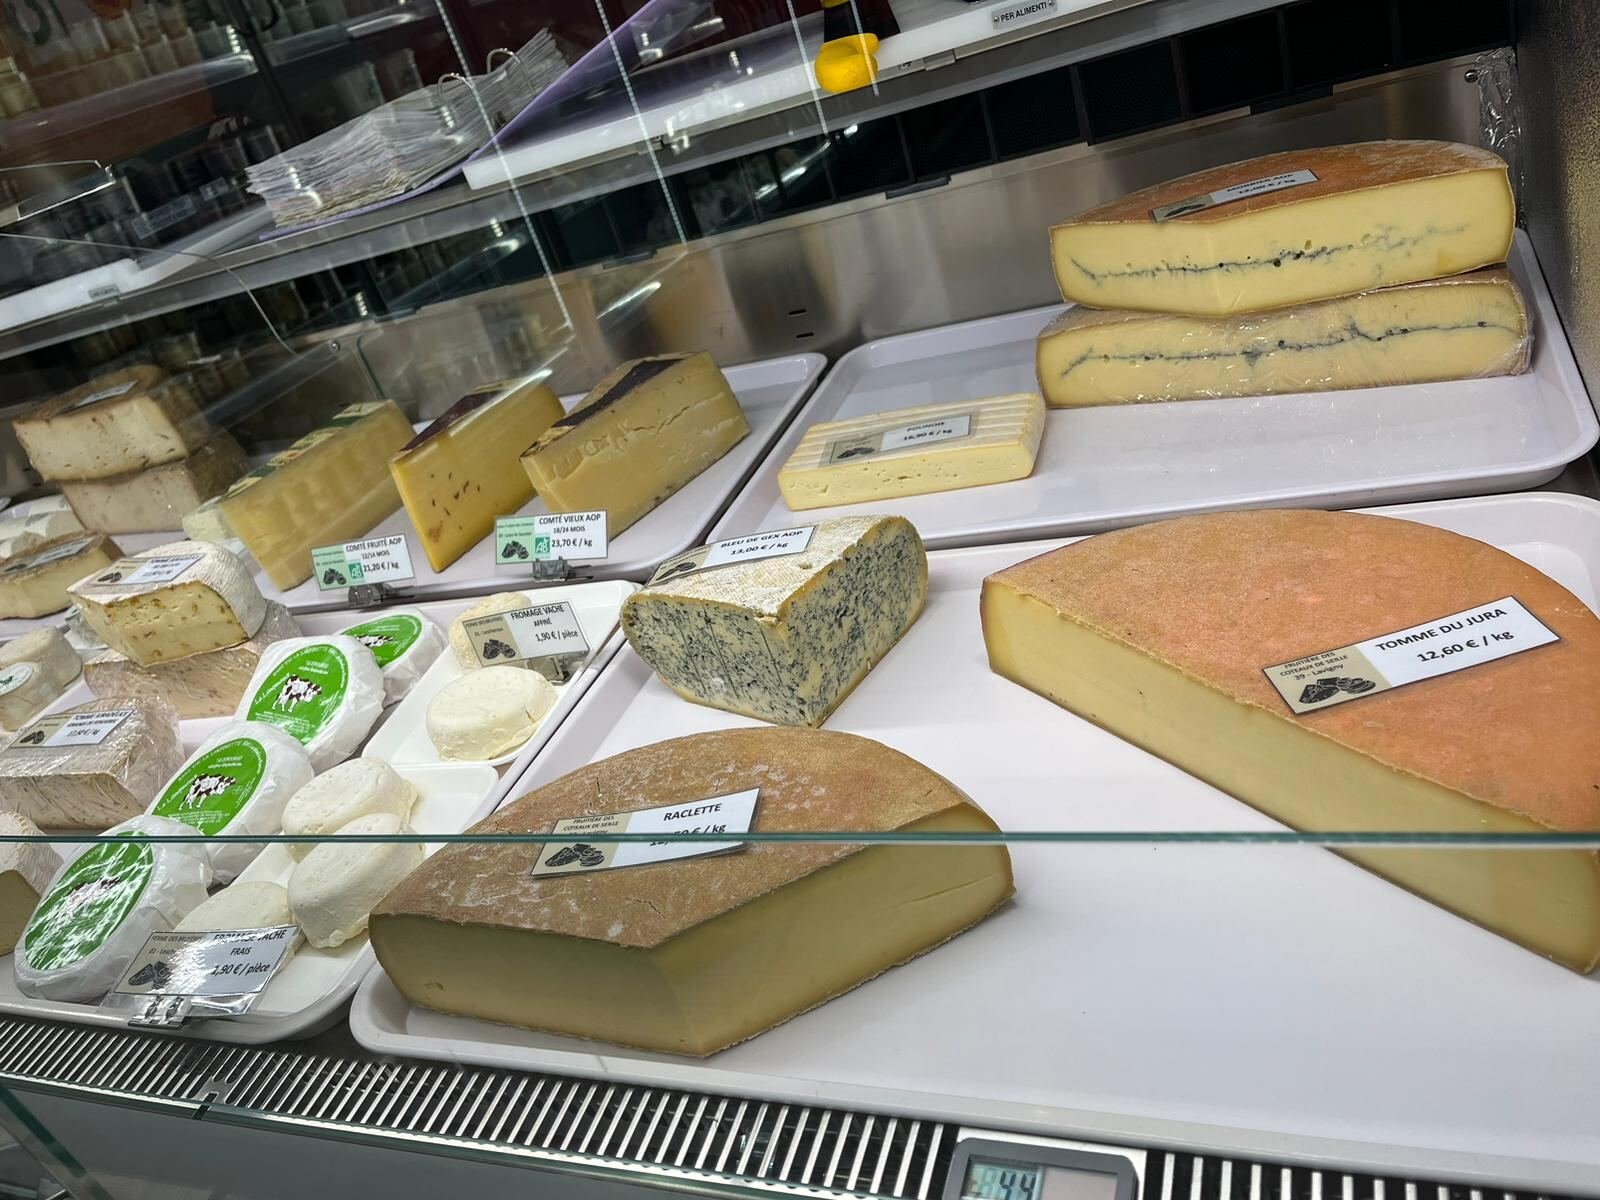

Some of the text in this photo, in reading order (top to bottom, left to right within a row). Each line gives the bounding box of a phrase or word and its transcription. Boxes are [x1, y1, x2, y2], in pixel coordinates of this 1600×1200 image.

[1000, 2, 1047, 22] PER ALIMENTI
[539, 513, 601, 525] COMTÉ VIEUX AOP
[388, 537, 402, 546] AOP
[552, 538, 570, 548] 23,70
[572, 538, 578, 546] €
[584, 538, 592, 547] kg
[720, 540, 744, 548] BLEU
[760, 533, 780, 541] GEX
[780, 530, 804, 538] AOP
[730, 546, 759, 556] 13,00
[381, 562, 386, 570] €
[392, 561, 400, 570] kg
[510, 606, 543, 620] FROMAGE
[543, 604, 565, 615] VACHE
[534, 617, 552, 627] AFFINÉ
[1375, 608, 1508, 652] TOMME DU JURA
[536, 632, 550, 643] 1,90
[551, 630, 558, 640] €
[562, 630, 579, 640] pièce
[1416, 630, 1515, 664] 12,60 € / kg
[1280, 664, 1314, 677] COTEAUX
[1326, 655, 1348, 664] SEILLE
[1284, 656, 1320, 669] FRUITIÈRE
[1312, 664, 1344, 676] Lavigny
[663, 803, 722, 821] RACLETTE
[573, 815, 602, 824] FRUITIÈRE
[712, 824, 727, 834] kg
[258, 930, 288, 941] ACHE
[230, 946, 252, 956] FRAIS
[210, 964, 234, 976] 1,90
[232, 963, 243, 976] €
[245, 962, 270, 976] pièce
